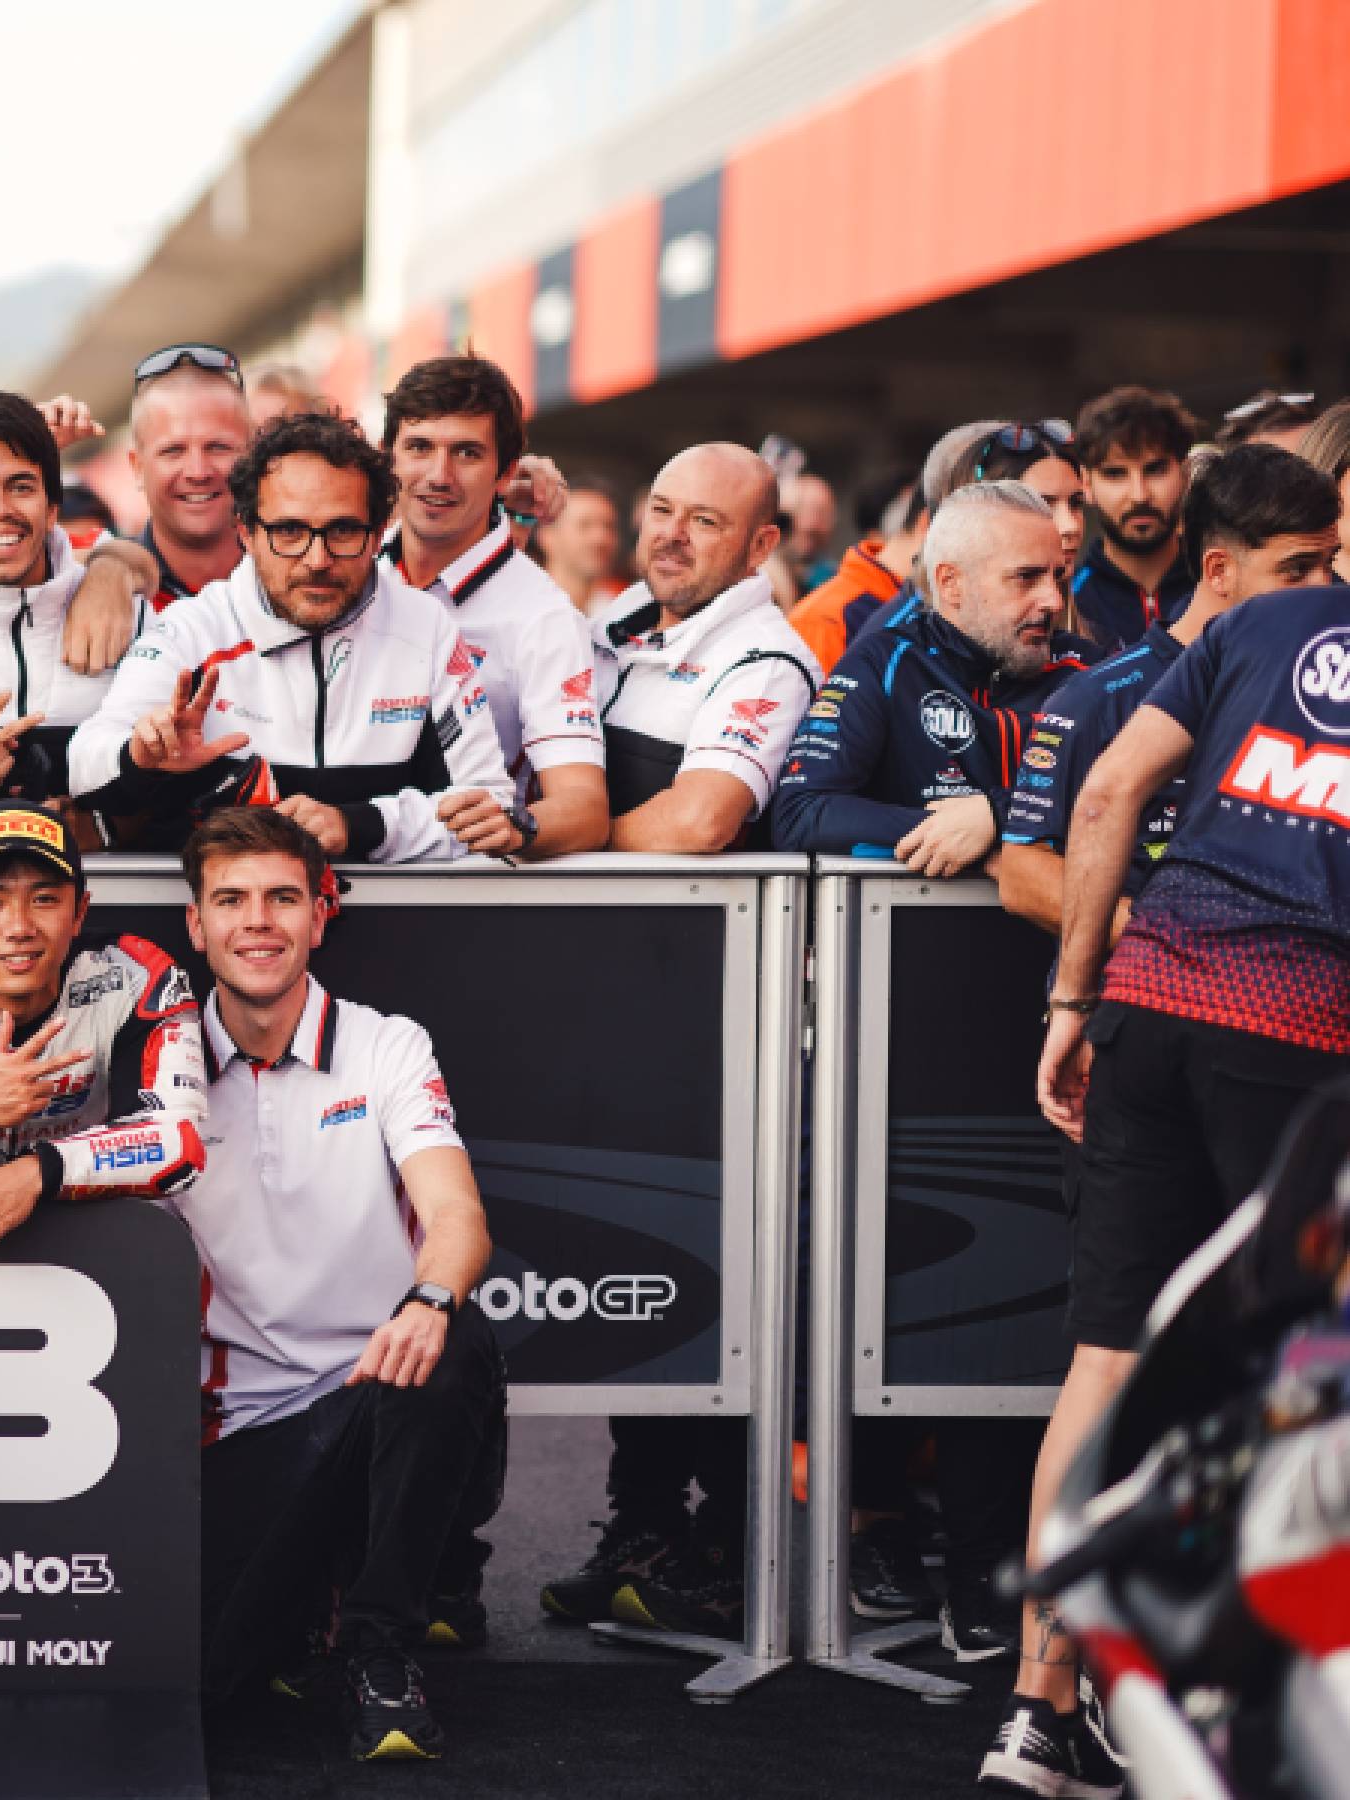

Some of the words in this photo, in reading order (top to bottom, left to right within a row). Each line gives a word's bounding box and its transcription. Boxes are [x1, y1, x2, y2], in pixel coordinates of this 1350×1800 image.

[89, 1131, 162, 1154] Honda
[469, 1270, 677, 1322] otoGP
[26, 1640, 113, 1667] MOLY
